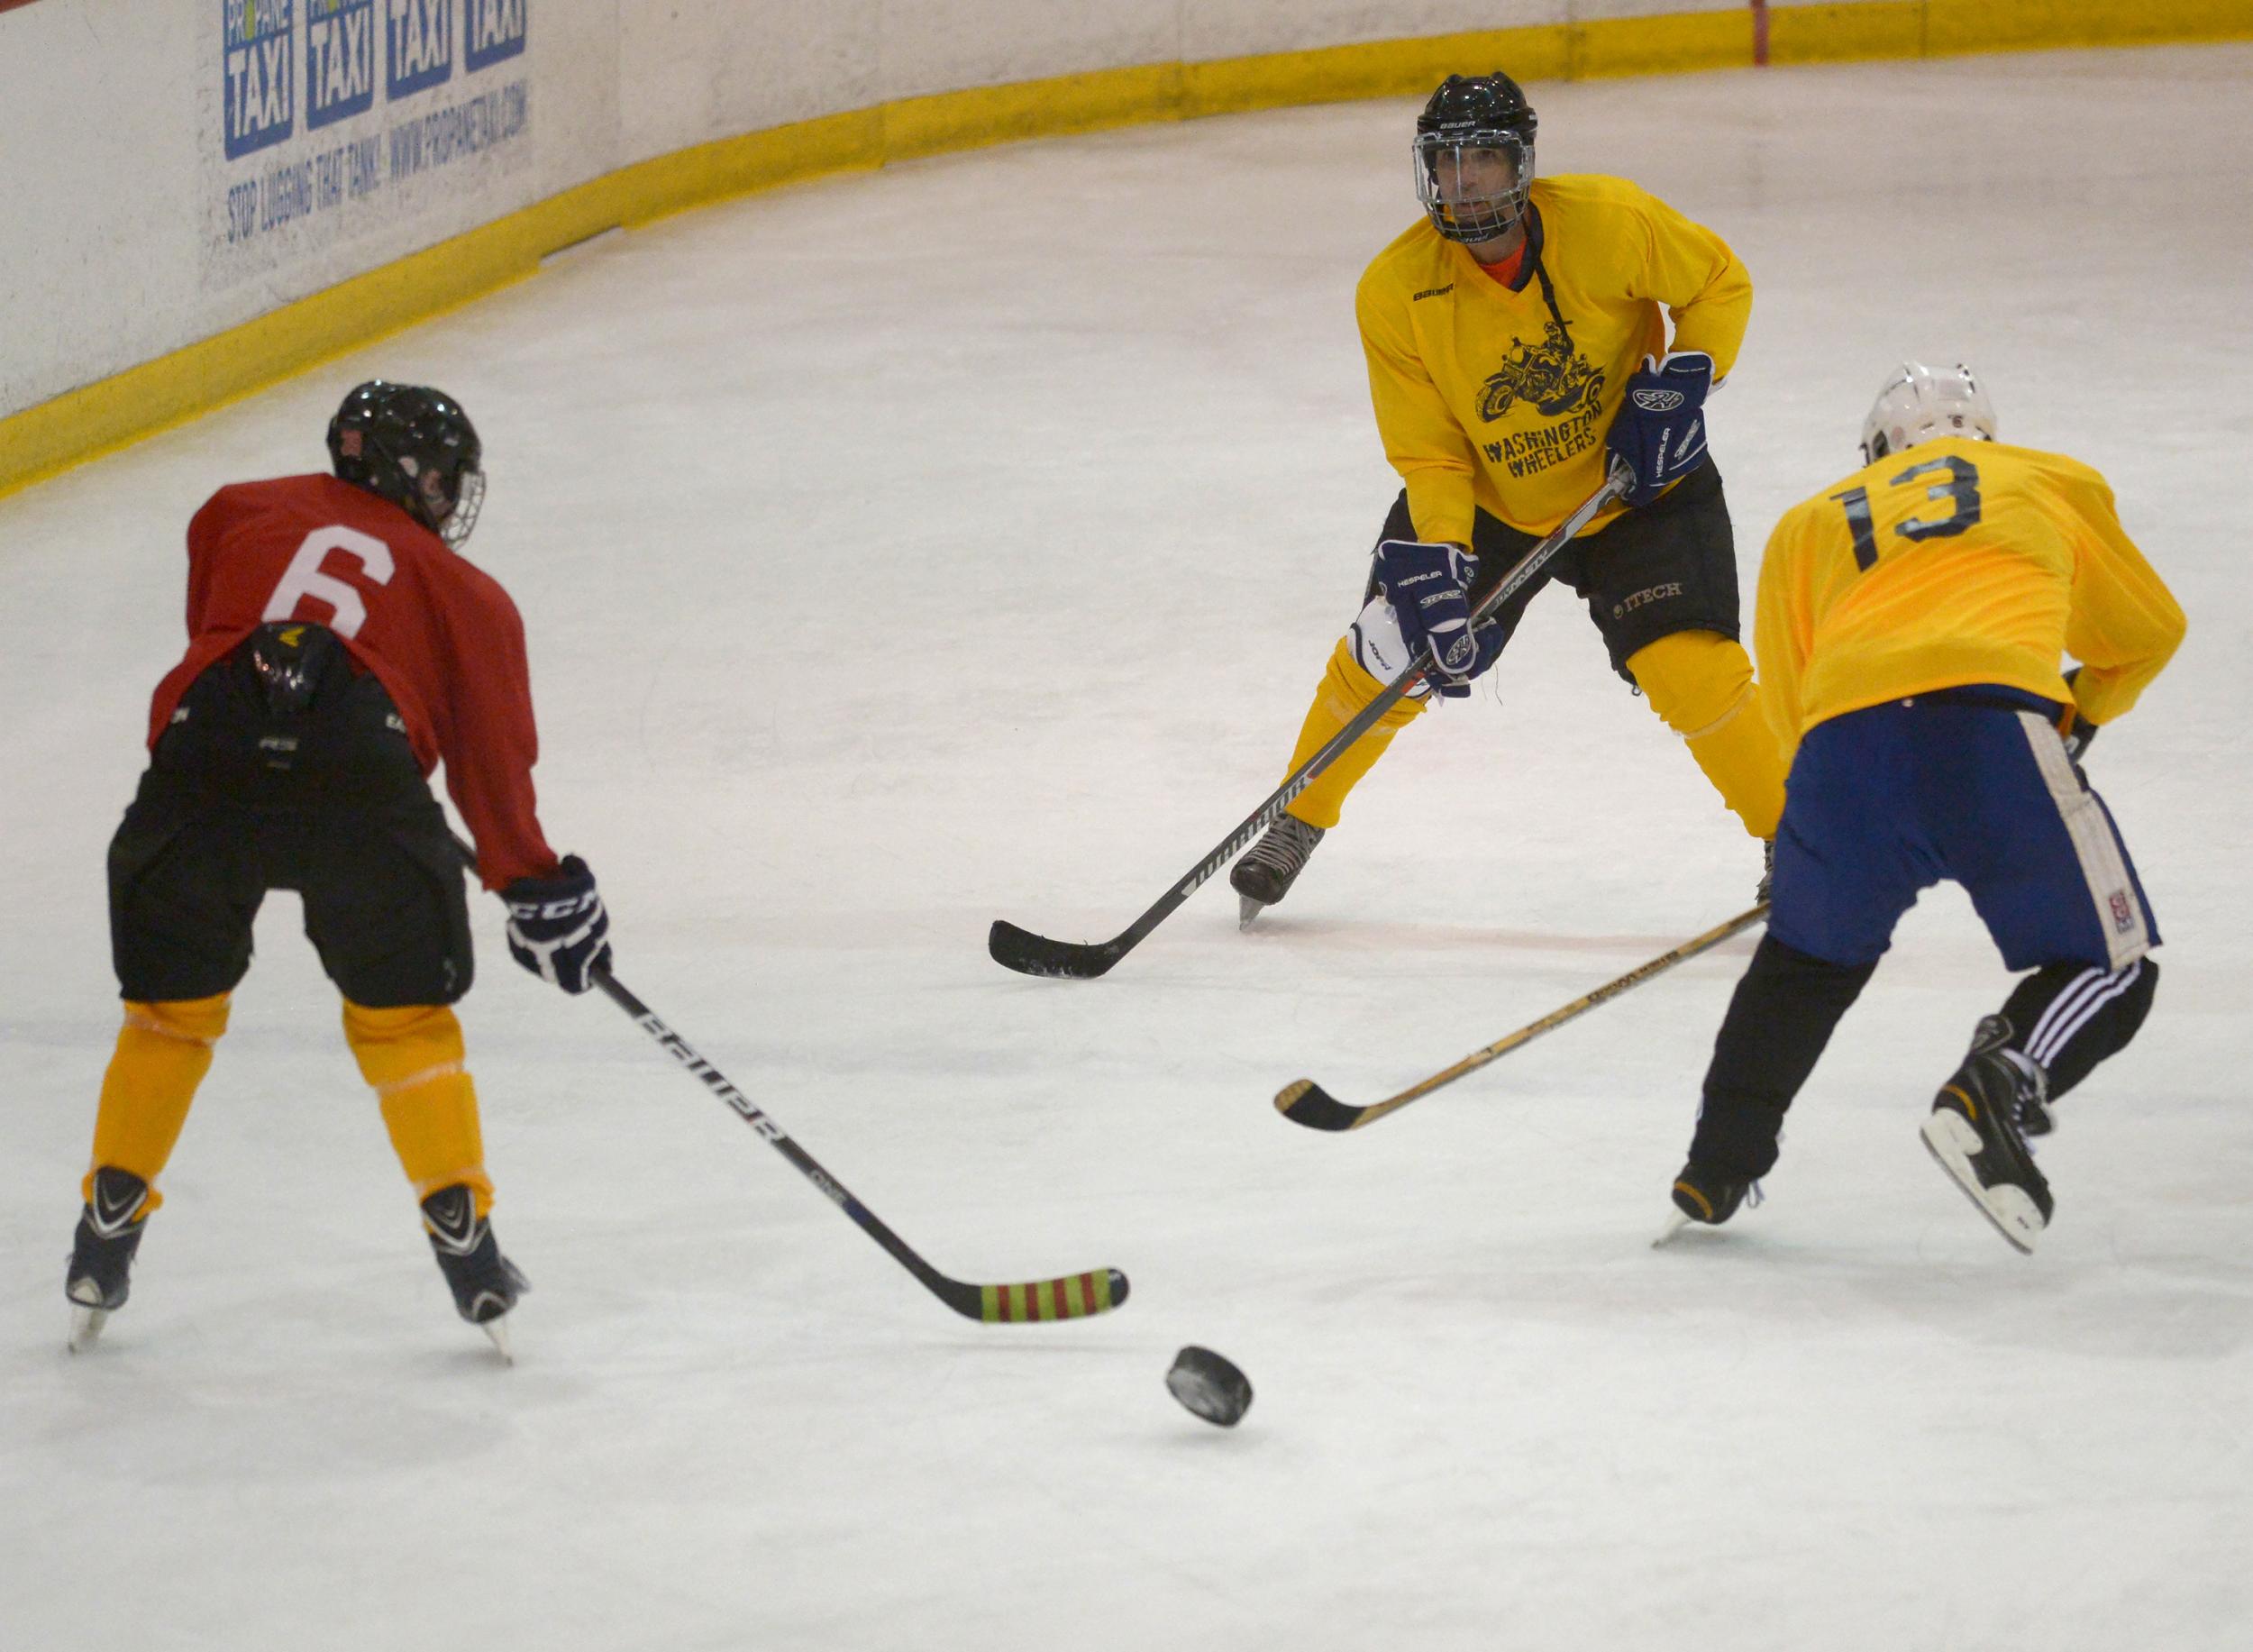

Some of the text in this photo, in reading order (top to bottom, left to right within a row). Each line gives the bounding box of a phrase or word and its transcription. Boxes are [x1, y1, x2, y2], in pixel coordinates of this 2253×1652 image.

[311, 7, 371, 110] TAXI
[390, 0, 448, 82] TAXI
[228, 34, 289, 140] TAXI
[1440, 121, 1476, 130] BAUER
[228, 180, 257, 244] STOP
[1482, 399, 1601, 463] WASHINGTON
[1508, 427, 1597, 479] WHEELERS
[1656, 426, 1671, 479] HESPELER
[1829, 454, 1982, 573] 13
[261, 525, 396, 641] 6
[1398, 570, 1443, 589] HESPELER
[1623, 582, 1683, 613] ITECH
[640, 1011, 787, 1143] BAUER
